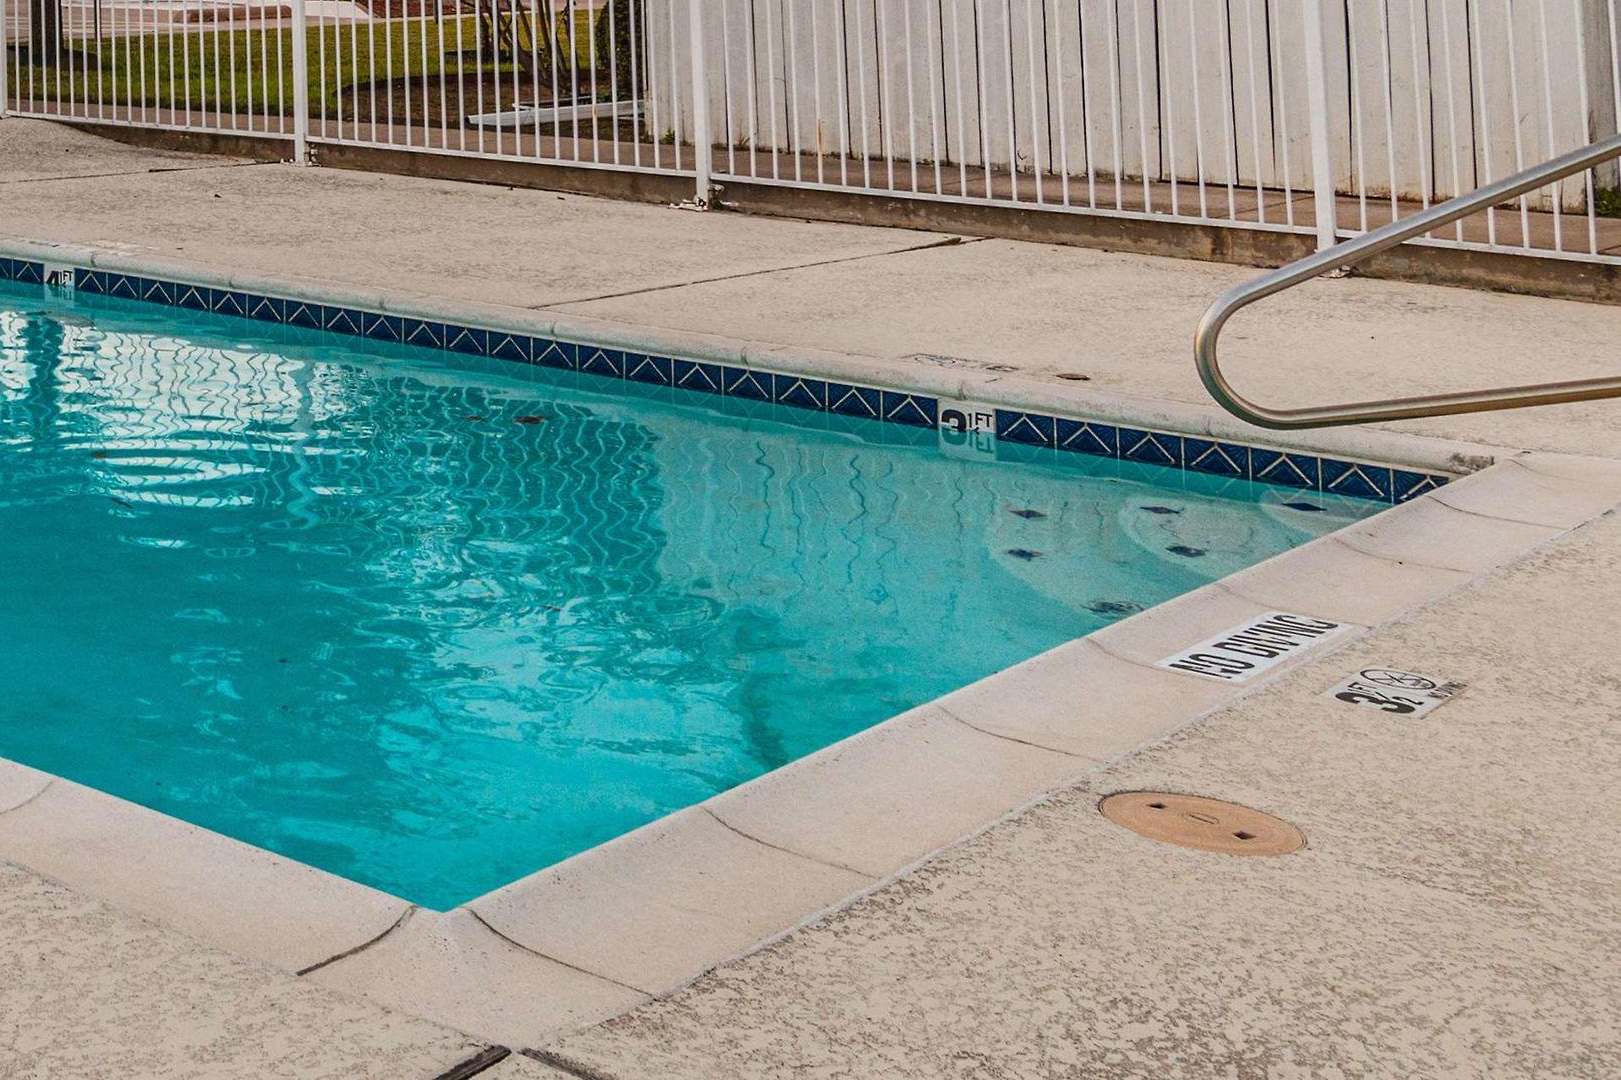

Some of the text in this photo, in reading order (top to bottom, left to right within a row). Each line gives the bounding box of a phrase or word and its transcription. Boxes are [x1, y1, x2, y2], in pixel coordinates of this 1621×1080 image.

[975, 412, 992, 428] FT
[1169, 615, 1338, 679] NO DIVING
